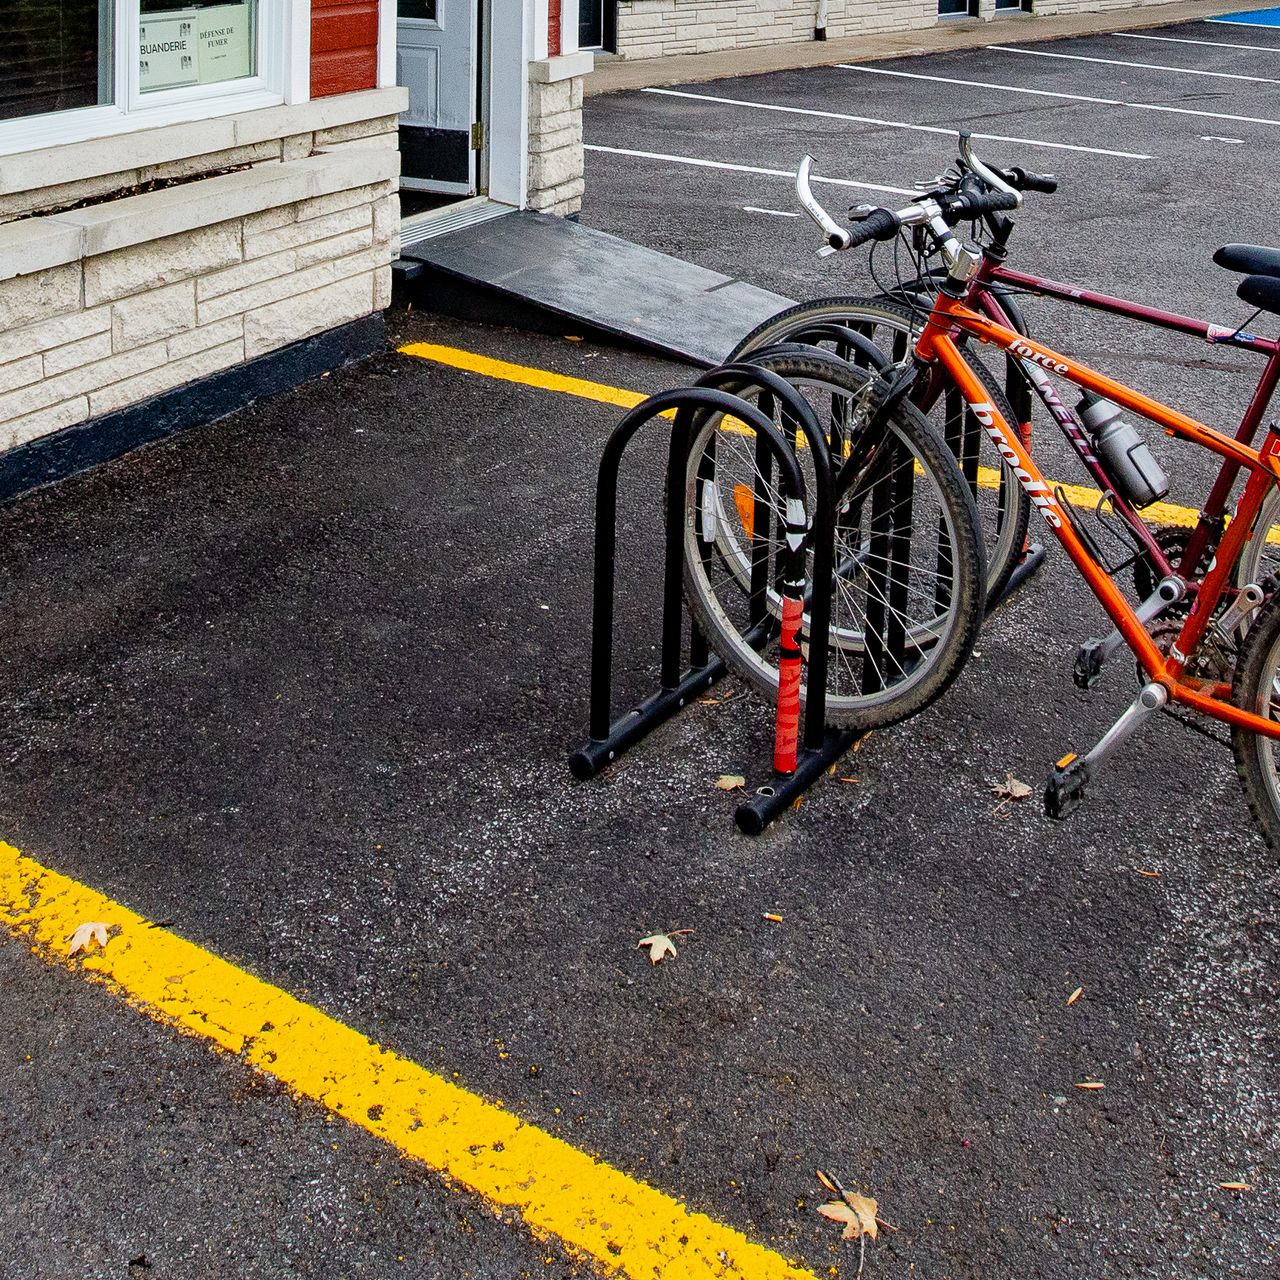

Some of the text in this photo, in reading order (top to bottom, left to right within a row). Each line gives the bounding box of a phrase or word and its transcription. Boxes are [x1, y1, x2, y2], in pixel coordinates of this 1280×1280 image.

[199, 26, 235, 40] DÉFENSE DE
[140, 40, 187, 55] BUANDERIE
[207, 38, 228, 48] FUMER
[1008, 338, 1070, 376] force
[968, 401, 1062, 529] brodie
